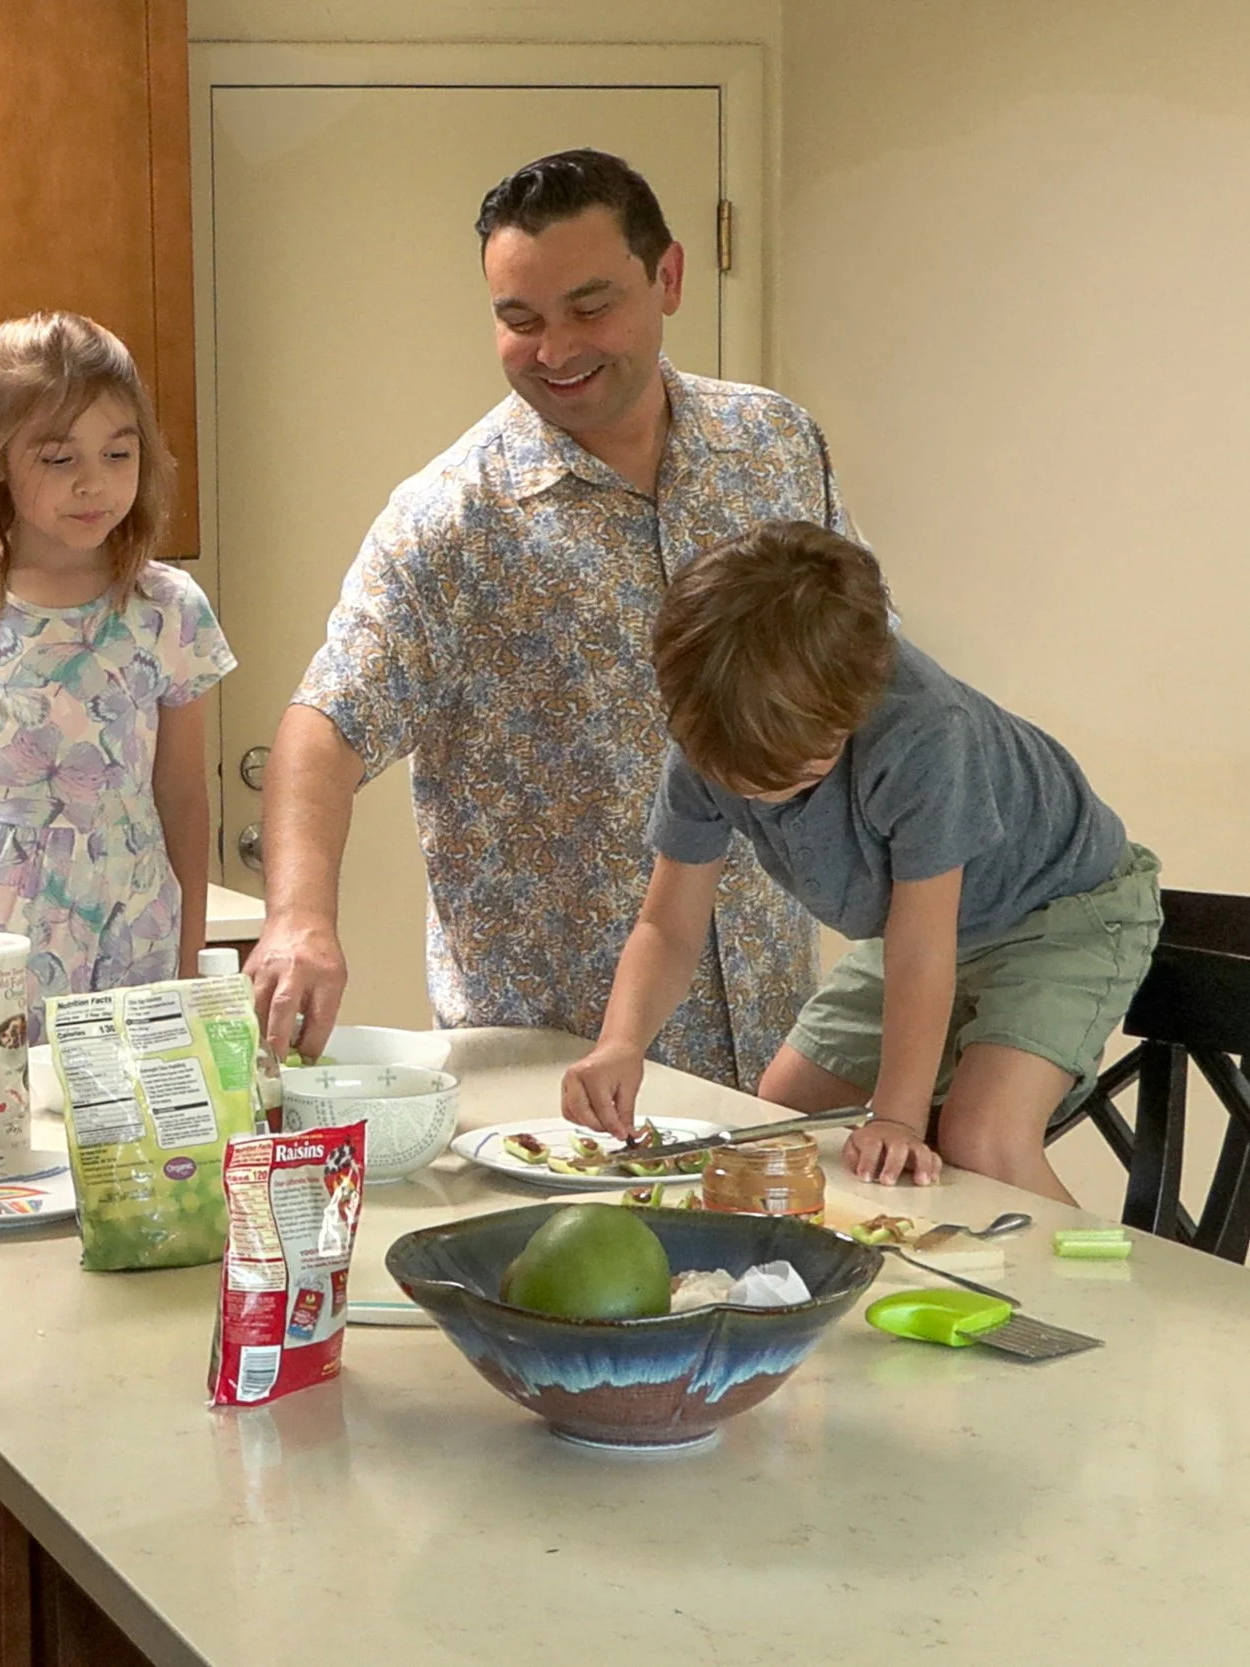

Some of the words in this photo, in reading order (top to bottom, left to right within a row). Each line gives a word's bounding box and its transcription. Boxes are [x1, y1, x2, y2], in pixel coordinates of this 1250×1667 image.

[57, 999, 89, 1009] Nutrition
[90, 996, 112, 1005] Facts
[57, 1030, 86, 1040] Calories
[275, 1140, 325, 1162] Raisins
[253, 1169, 267, 1180] 120
